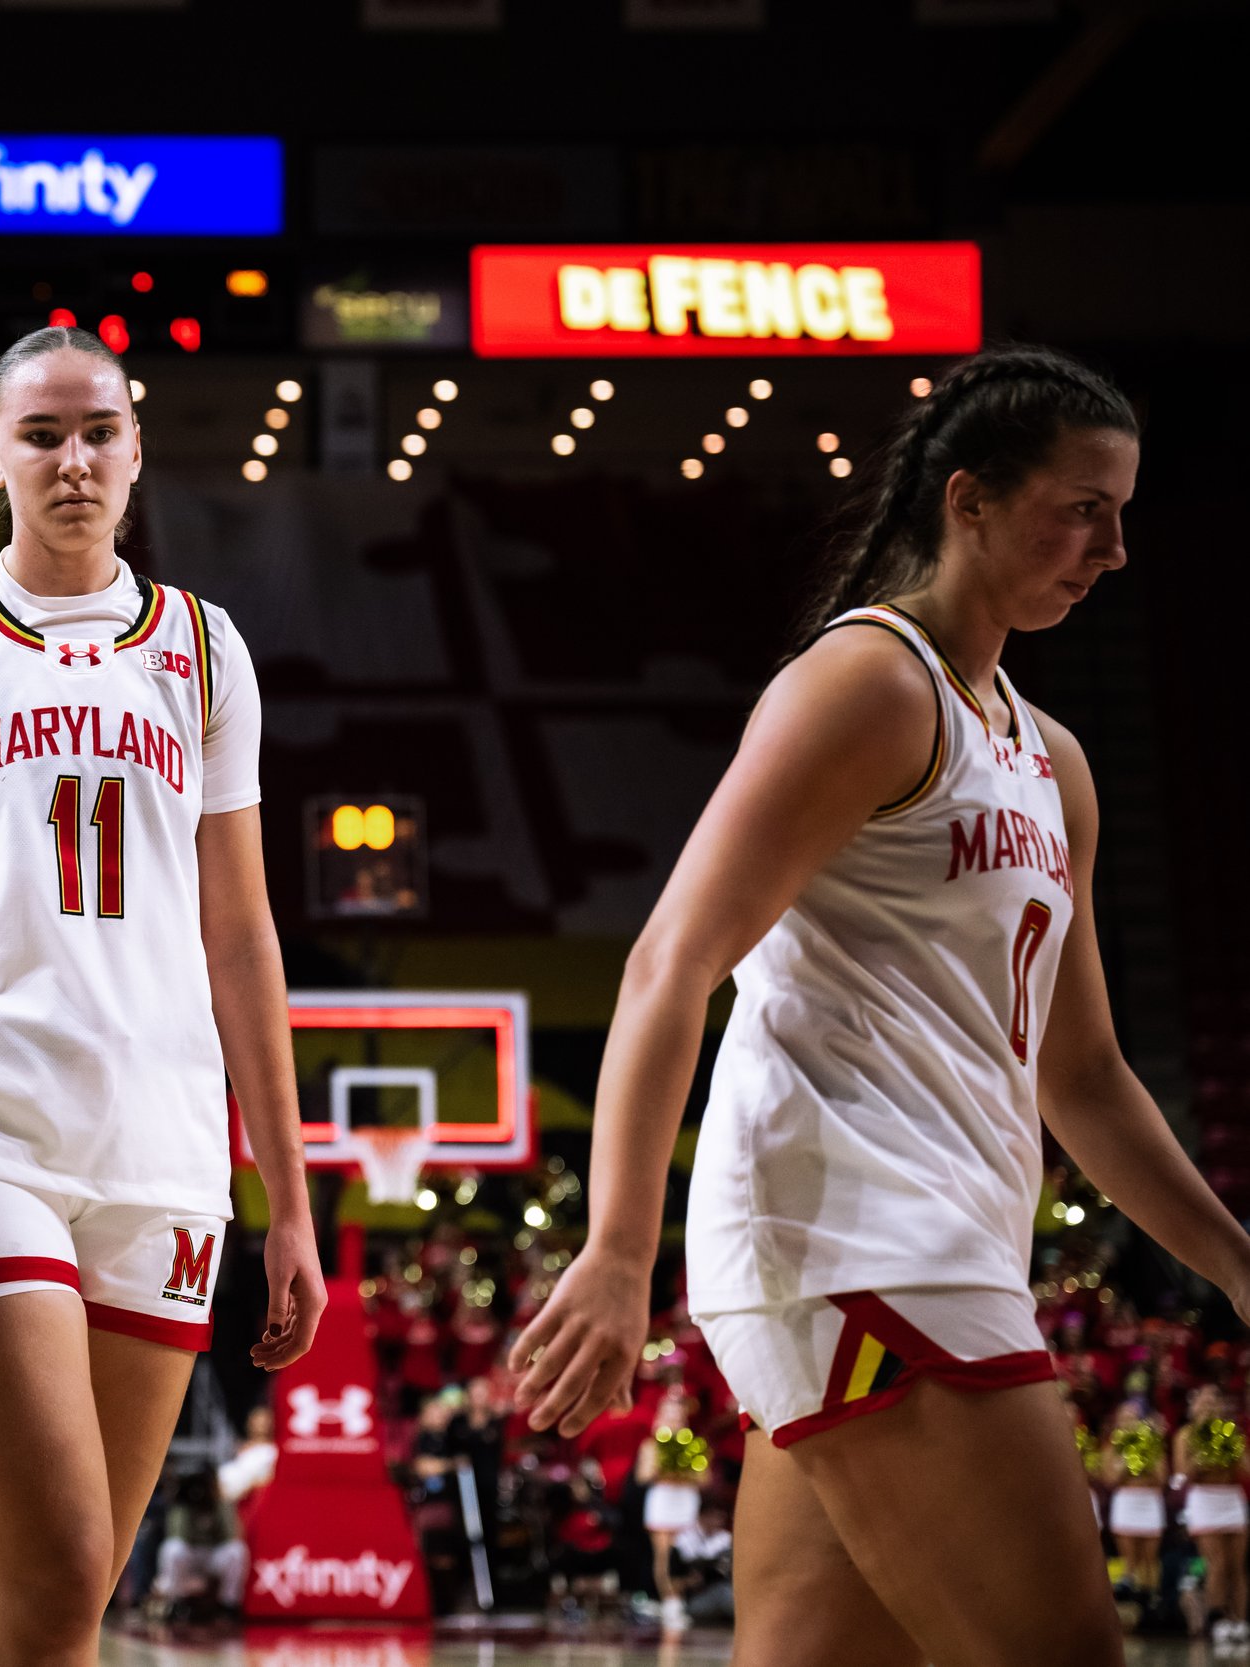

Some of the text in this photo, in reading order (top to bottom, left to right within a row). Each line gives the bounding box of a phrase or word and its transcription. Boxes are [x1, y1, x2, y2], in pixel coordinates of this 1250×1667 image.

[47, 774, 125, 919] 11
[1010, 897, 1052, 1066] 0
[164, 1227, 216, 1297] M
[253, 1545, 414, 1608] xfinity
